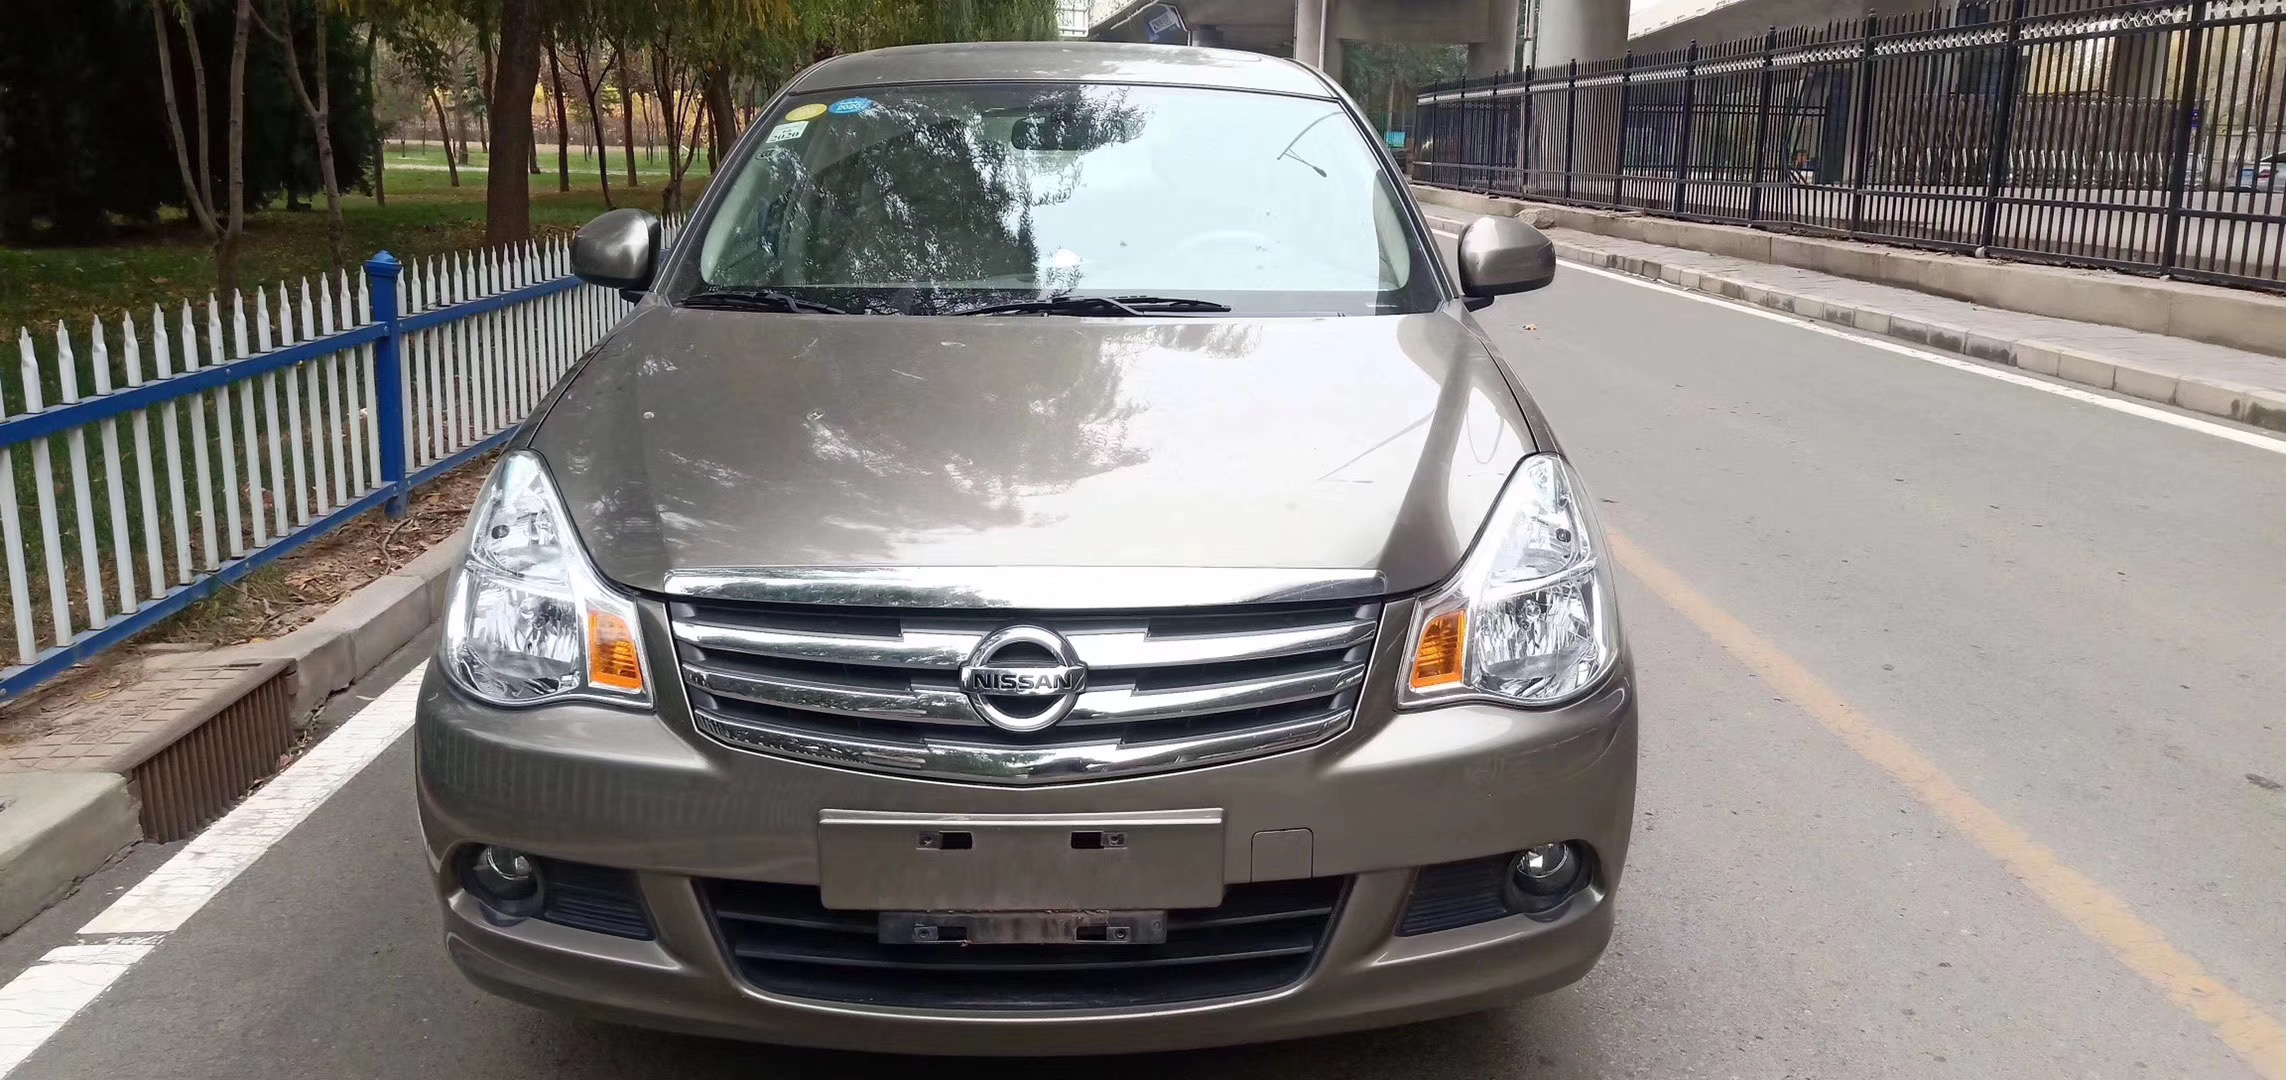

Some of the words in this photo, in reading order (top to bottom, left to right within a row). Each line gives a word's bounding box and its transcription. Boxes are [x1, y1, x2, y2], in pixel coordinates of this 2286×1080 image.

[836, 103, 861, 111] 2020
[770, 132, 799, 141] 2020
[972, 673, 1073, 690] NISSAN
